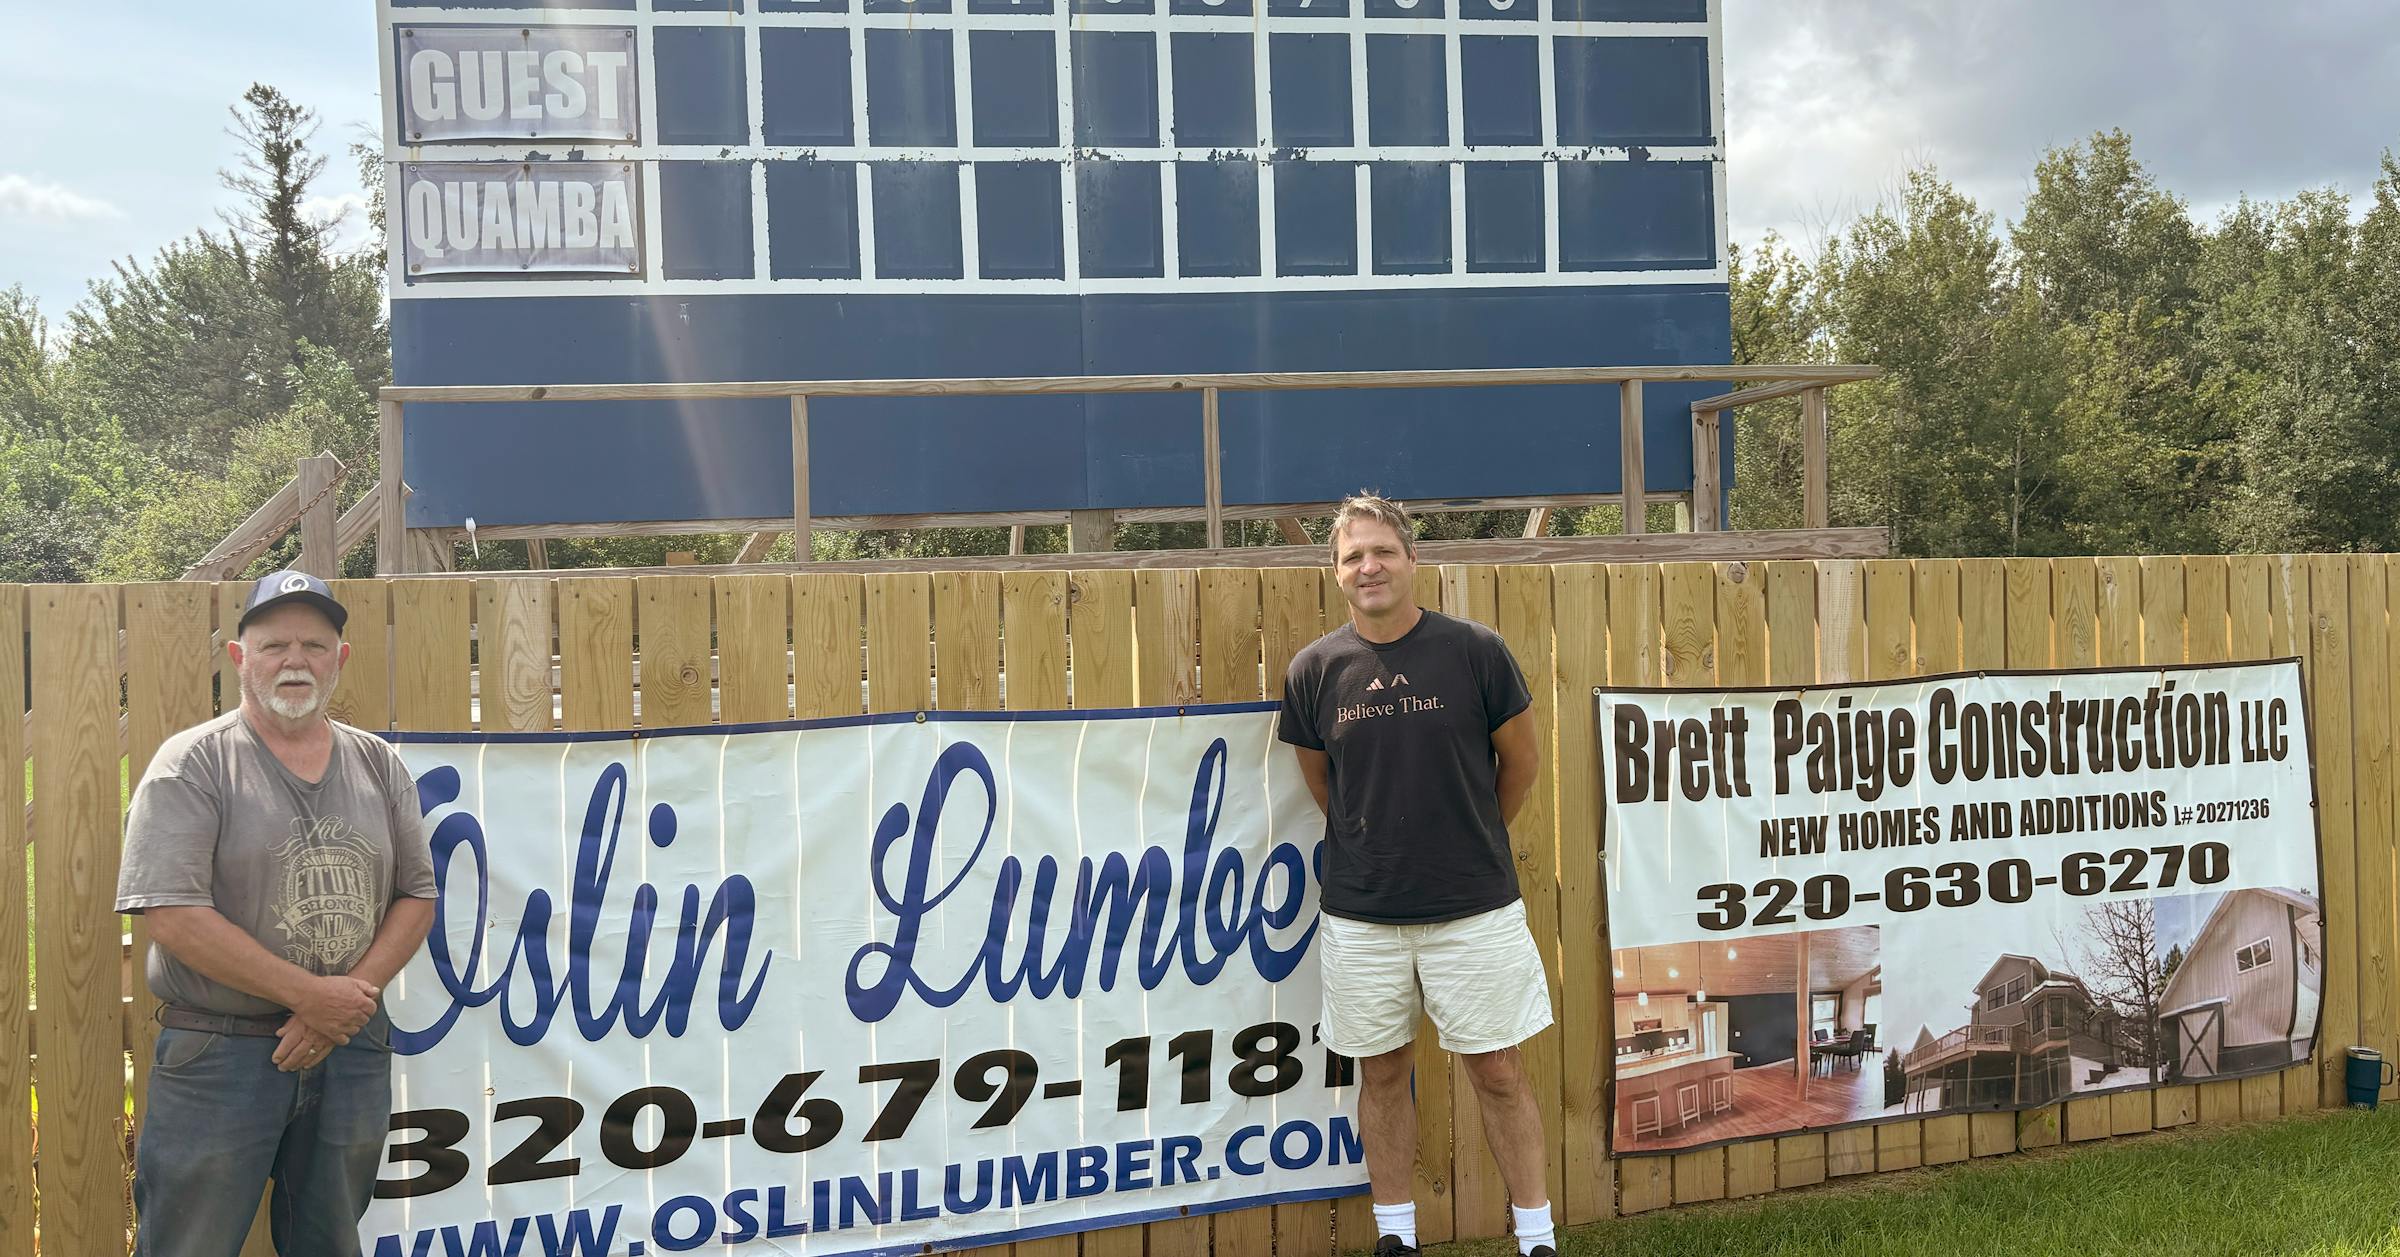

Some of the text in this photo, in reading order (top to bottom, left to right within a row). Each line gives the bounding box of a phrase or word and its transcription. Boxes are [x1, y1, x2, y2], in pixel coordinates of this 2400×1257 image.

[410, 50, 627, 121] GUEST
[409, 180, 635, 258] QUAMBA
[1337, 696, 1444, 723] Believe That.
[1616, 681, 2288, 804] Brett Paige Construction LLC
[289, 814, 353, 841] The
[1760, 817, 1828, 858] NEW
[1840, 807, 1940, 850] HOMES
[1951, 803, 2012, 842] AND
[2020, 791, 2168, 836] ADDITIONS
[2197, 799, 2270, 823] 20271236
[386, 738, 1325, 1057] Oslin Lumbe
[1697, 842, 2230, 931] 320-630-6270
[310, 938, 357, 951] HOSE
[322, 914, 343, 938] TO
